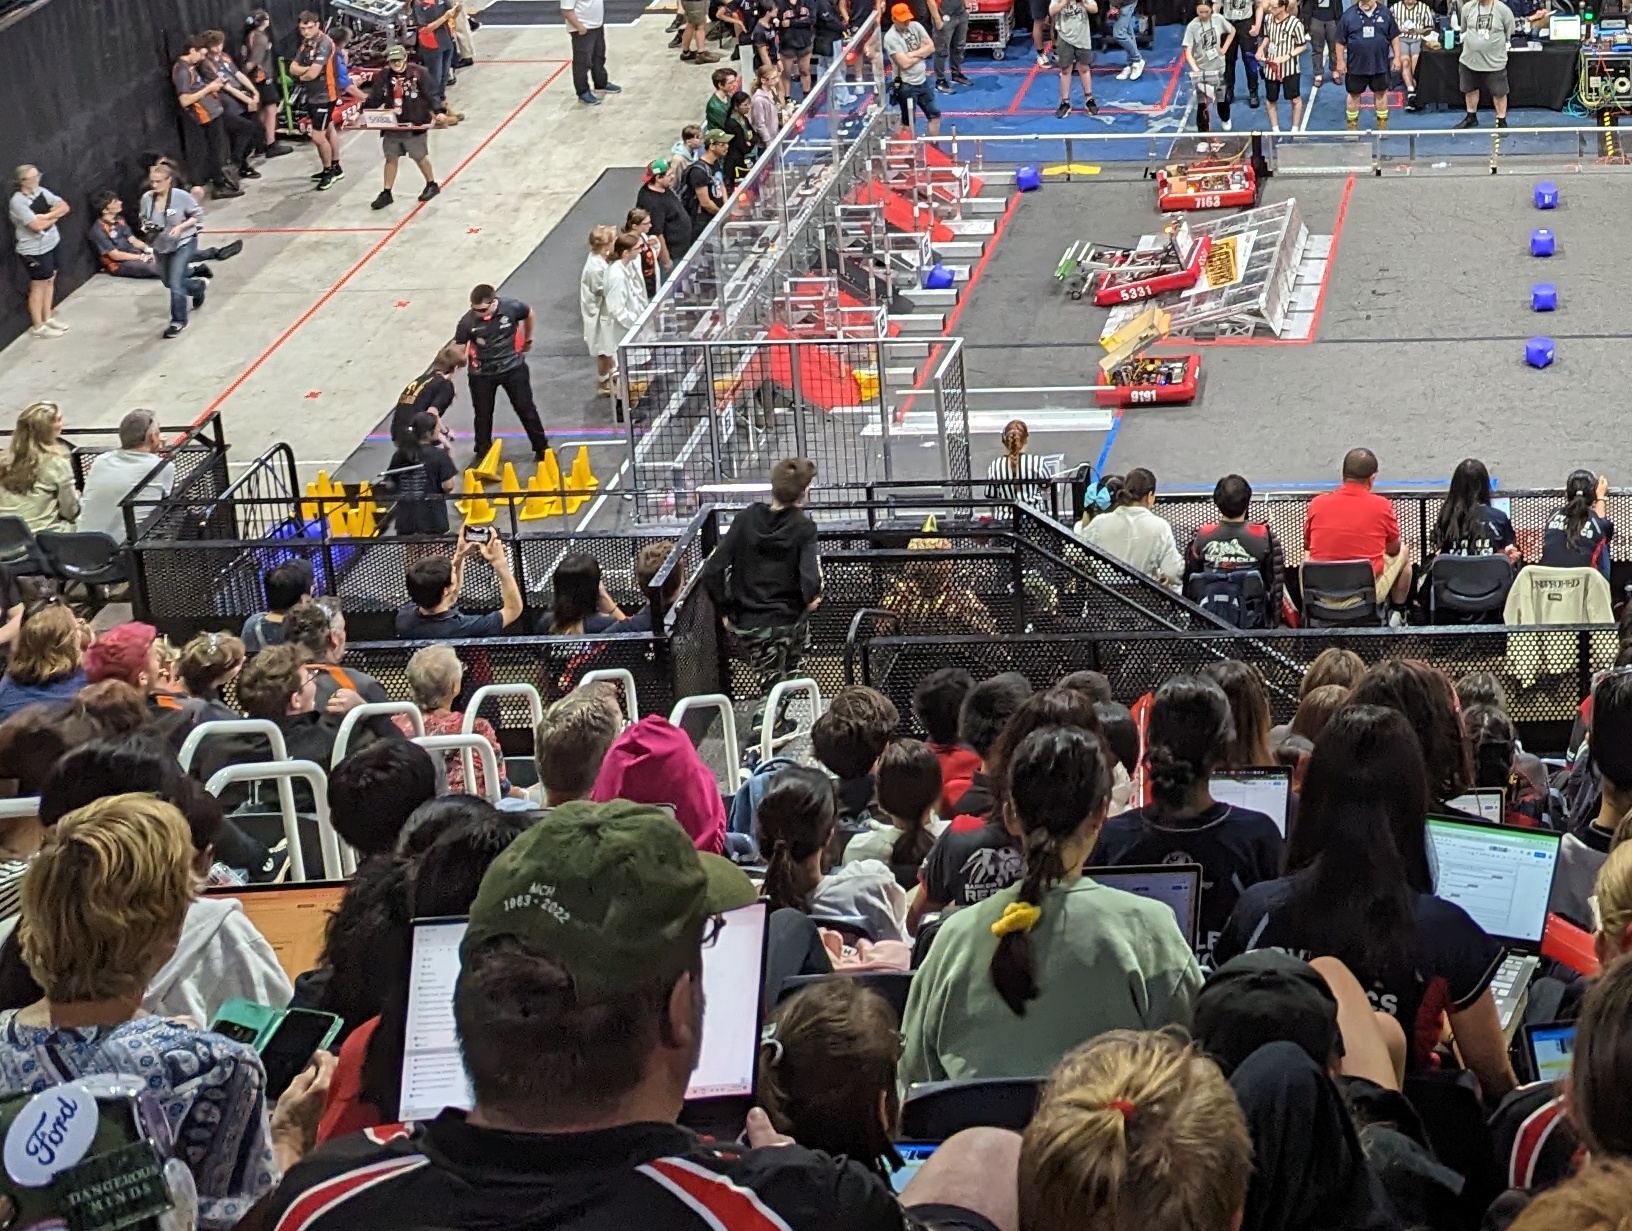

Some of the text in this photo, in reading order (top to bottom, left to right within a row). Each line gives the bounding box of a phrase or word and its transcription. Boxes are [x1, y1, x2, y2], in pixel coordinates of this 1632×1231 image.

[1195, 196, 1221, 209] 7163
[1120, 284, 1153, 302] 5331
[1130, 389, 1158, 403] 9191
[25, 1096, 78, 1166] Ford
